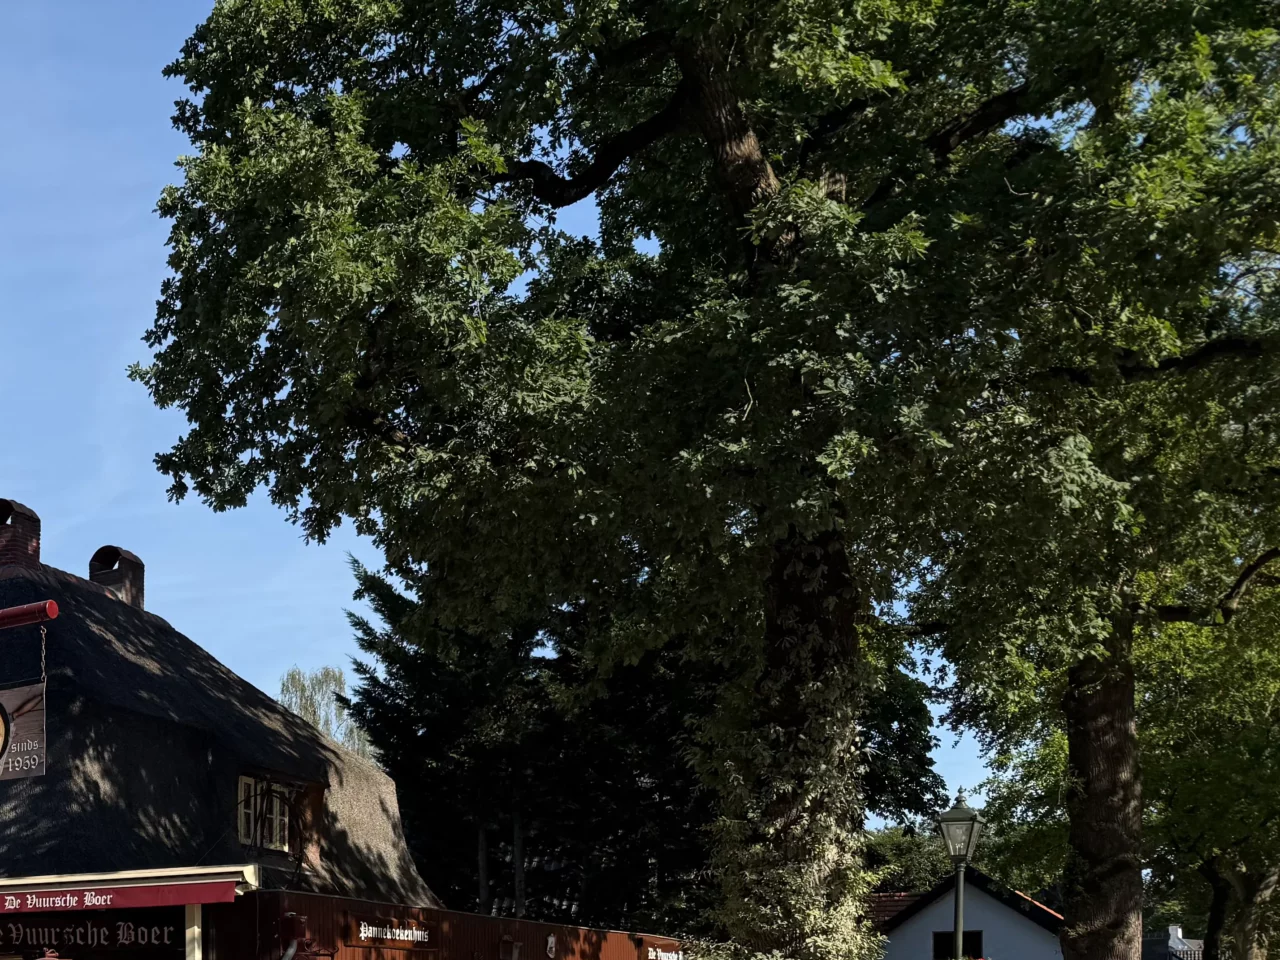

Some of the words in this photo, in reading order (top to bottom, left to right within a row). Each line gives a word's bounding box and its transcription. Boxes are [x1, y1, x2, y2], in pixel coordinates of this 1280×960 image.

[11, 739, 39, 753] sinds
[8, 754, 39, 772] 1959
[4, 895, 21, 910] De
[26, 893, 78, 909] Vuursche
[83, 890, 113, 909] Boer
[8, 920, 110, 949] Vuursche
[116, 921, 175, 947] Boer
